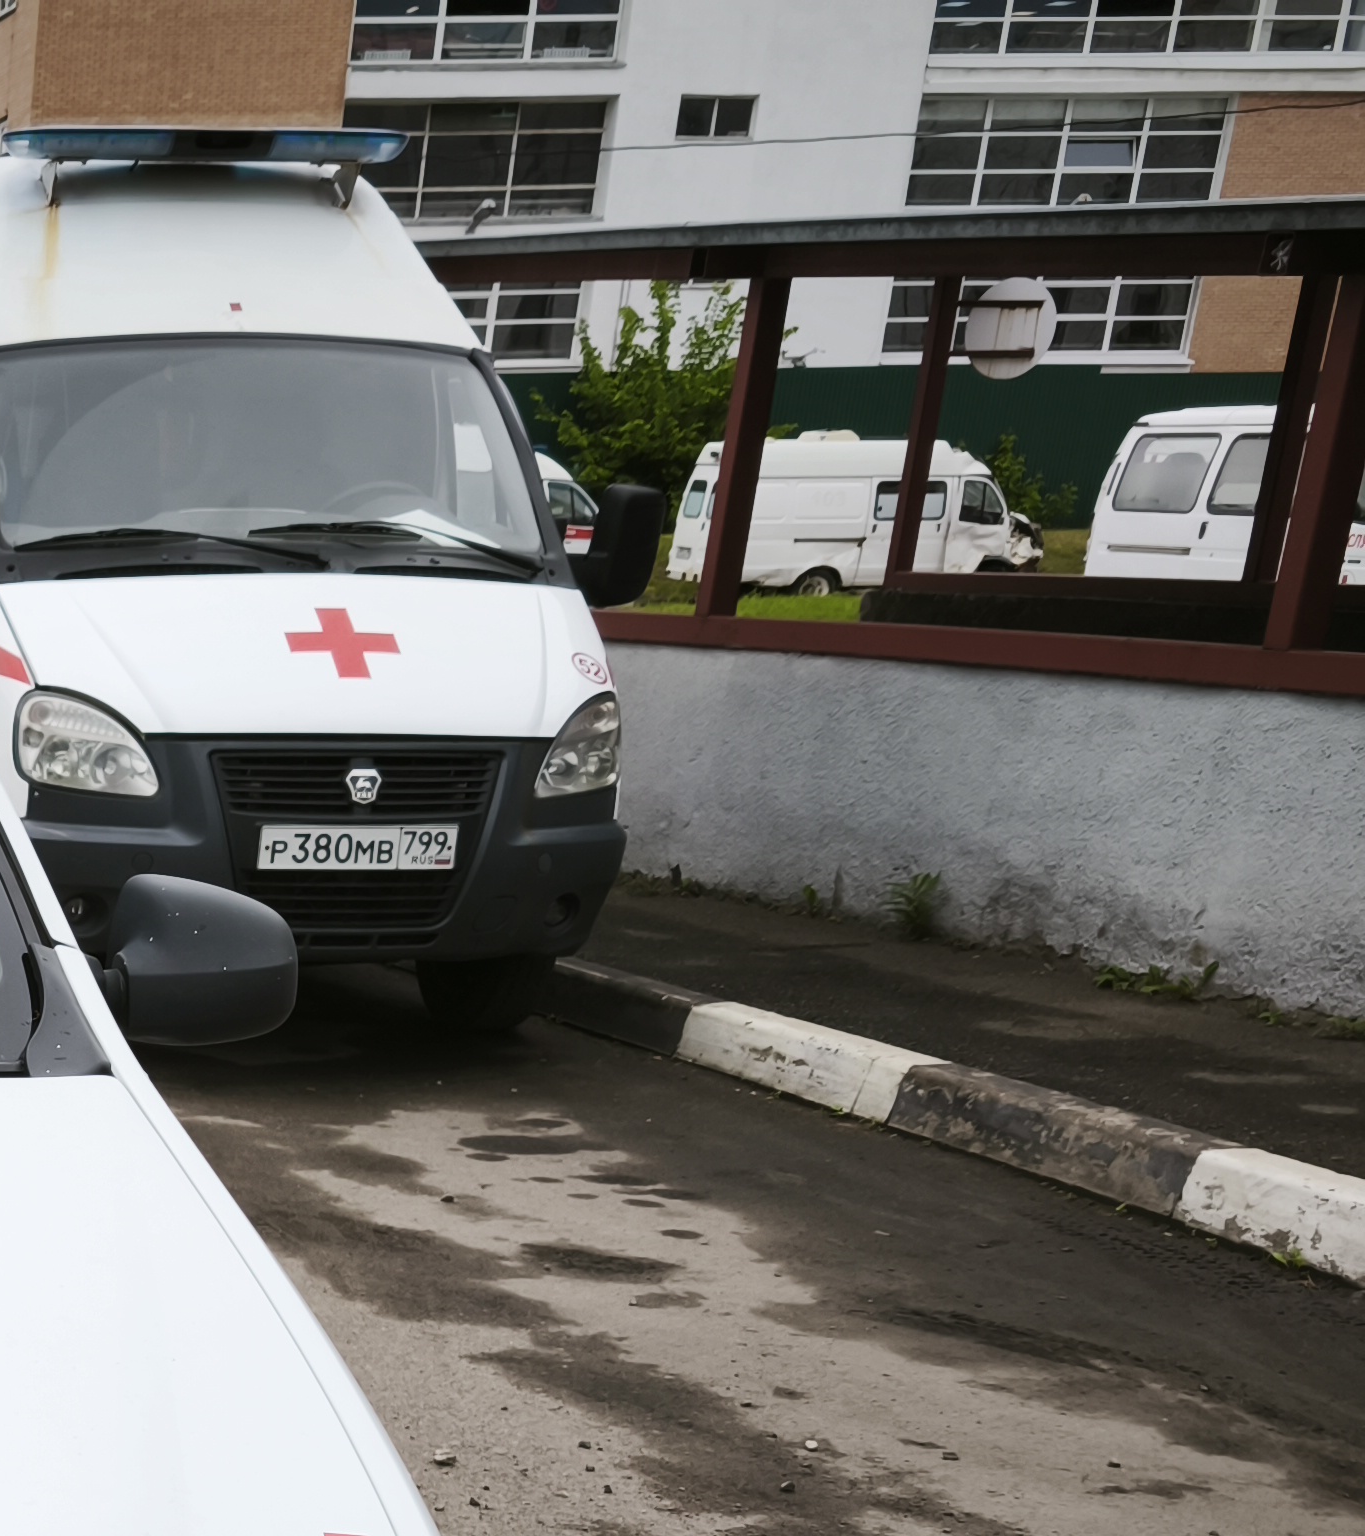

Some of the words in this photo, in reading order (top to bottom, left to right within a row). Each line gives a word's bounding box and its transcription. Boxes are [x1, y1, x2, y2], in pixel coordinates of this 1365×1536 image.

[579, 658, 604, 680] 52
[269, 833, 394, 864] Р380МВ
[403, 831, 448, 855] 799
[411, 855, 434, 865] RUS
